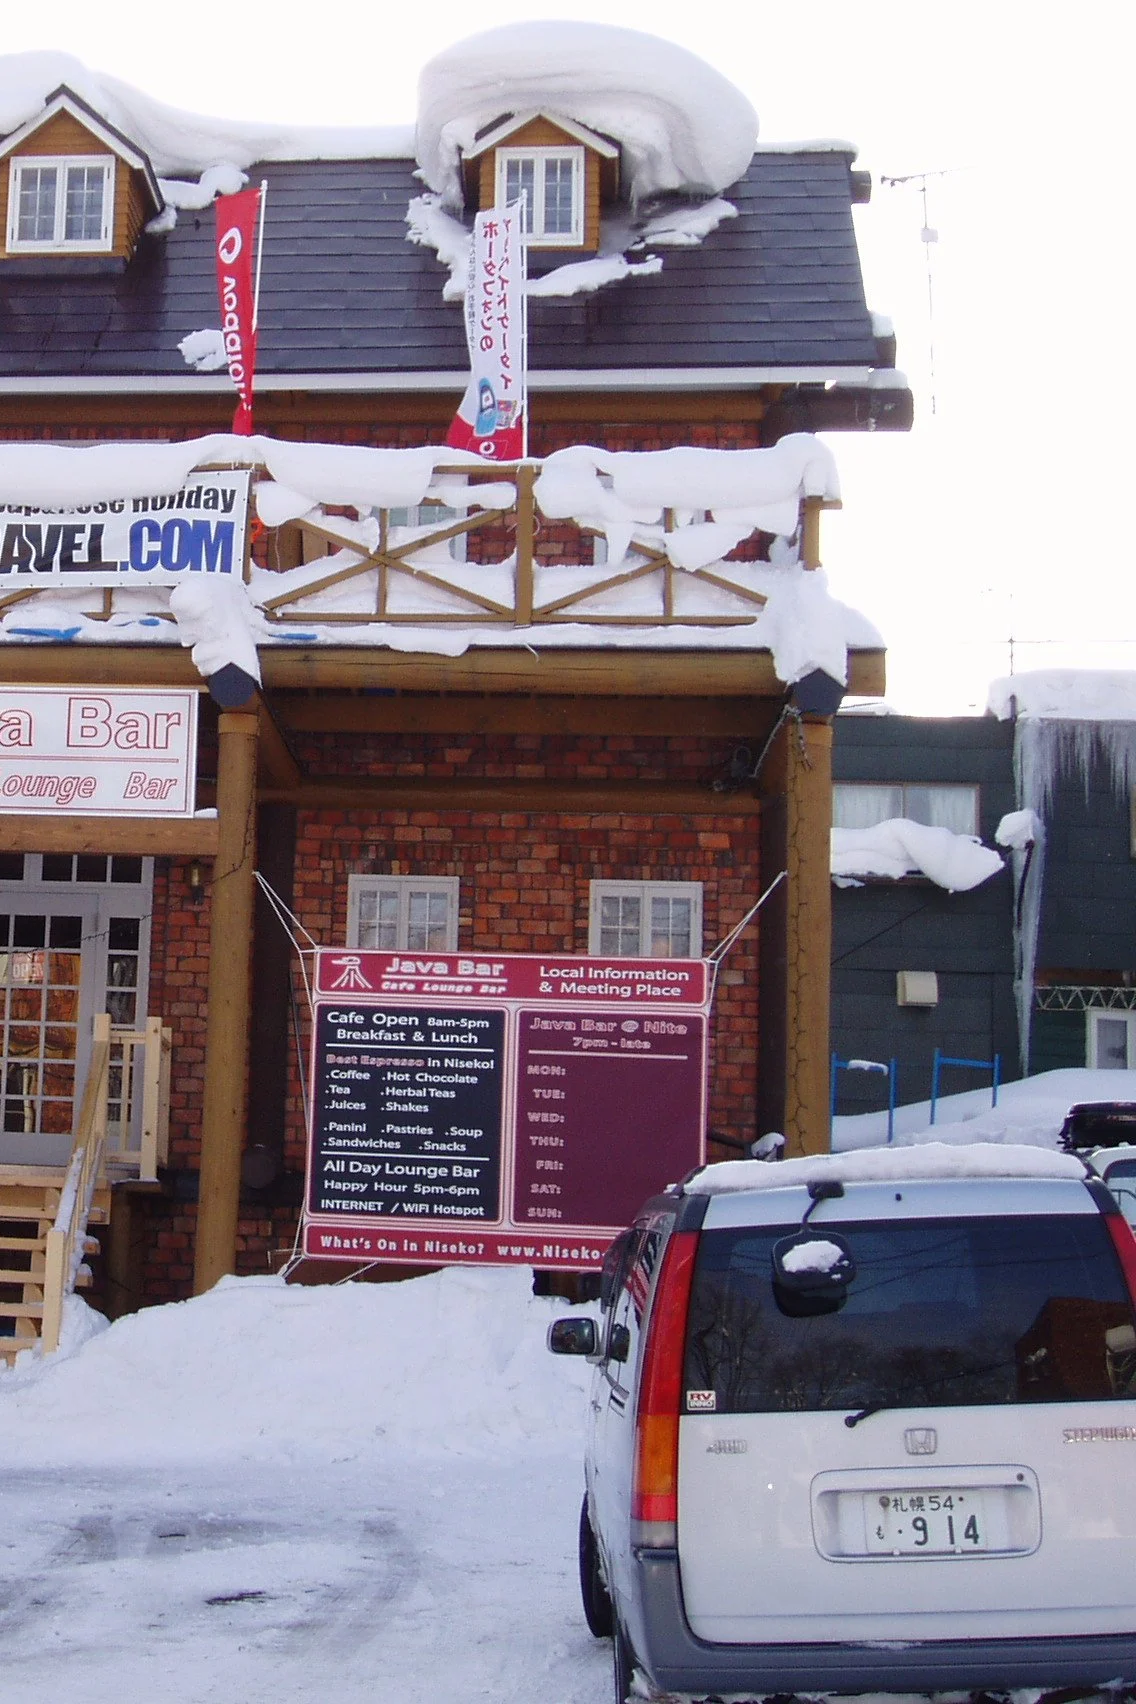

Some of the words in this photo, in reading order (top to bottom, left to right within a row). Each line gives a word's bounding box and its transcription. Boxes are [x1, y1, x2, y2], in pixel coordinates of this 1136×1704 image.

[67, 697, 181, 749] Bar
[123, 772, 177, 800] Bar
[386, 957, 448, 975] Java
[457, 960, 505, 976] Bar
[539, 966, 584, 978] Local
[588, 967, 689, 981] Information
[381, 980, 415, 991] Cafe
[422, 982, 473, 994] Lounge
[479, 984, 506, 994] Bar
[539, 981, 552, 993] &
[560, 982, 631, 998] Meeting
[636, 984, 681, 996] Place
[327, 1011, 364, 1024] Cafe
[372, 1013, 419, 1027] Open
[427, 1017, 490, 1029] 8am-5pm
[530, 1017, 576, 1031] Java
[581, 1019, 617, 1032] Bar
[621, 1020, 639, 1033] @
[643, 1021, 688, 1035] Nite
[337, 1029, 406, 1042] Breakfast
[413, 1031, 424, 1042] &
[432, 1032, 478, 1044] Lunch
[572, 1037, 608, 1049] 7pm
[620, 1038, 651, 1049] late
[326, 1054, 358, 1065] Best
[360, 1055, 425, 1067] Espresso
[427, 1057, 440, 1067] in
[415, 1072, 478, 1084] Chocolate
[428, 1088, 456, 1098] Teas
[323, 1160, 345, 1172] All
[349, 1161, 382, 1176] Day
[385, 1163, 448, 1179] Lounge
[452, 1165, 480, 1178] Bar
[324, 1179, 368, 1192] Happy
[374, 1182, 408, 1192] Hour
[320, 1199, 384, 1211] INTERNET
[433, 1204, 485, 1217] Hotspot
[320, 1235, 371, 1249] What's
[377, 1238, 397, 1250] On
[403, 1239, 418, 1251] in
[424, 1240, 485, 1255] Niseko?
